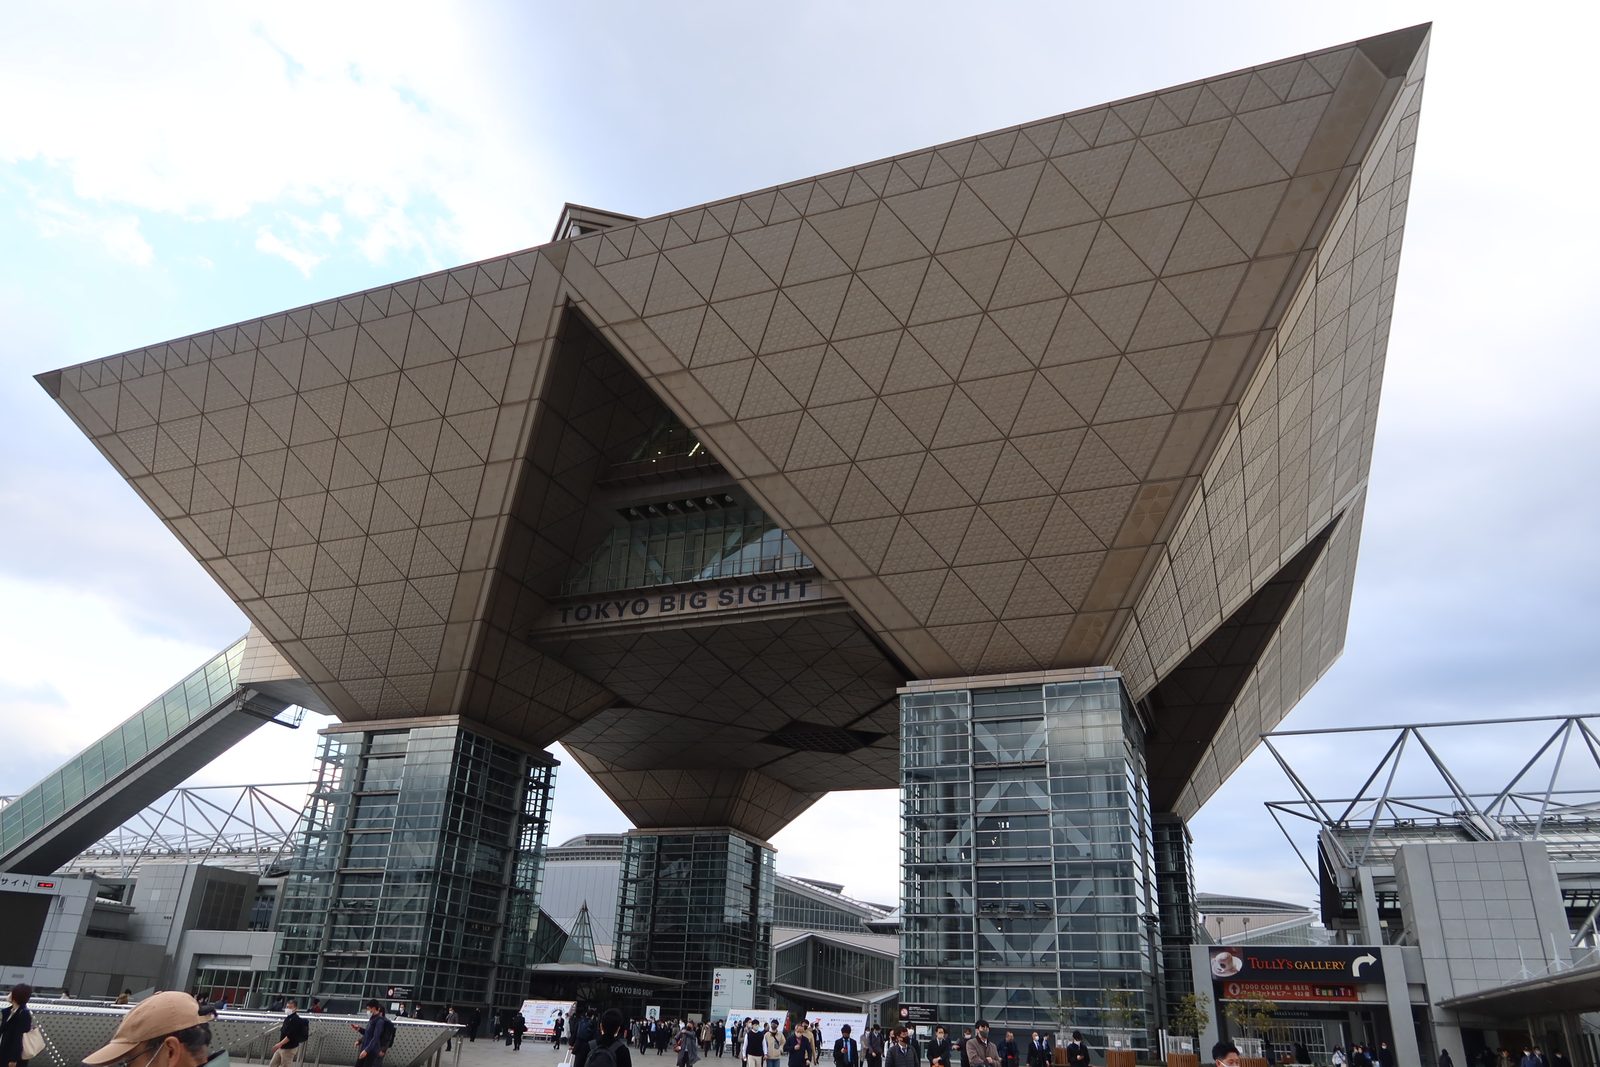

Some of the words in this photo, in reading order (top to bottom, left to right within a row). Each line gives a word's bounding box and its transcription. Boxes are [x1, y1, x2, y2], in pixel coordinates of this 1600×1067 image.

[558, 597, 650, 623] TOKYO
[659, 591, 707, 613] BIG
[718, 580, 813, 607] SIGHT
[1294, 960, 1346, 970] GALLERY
[610, 985, 632, 994] TOKYO
